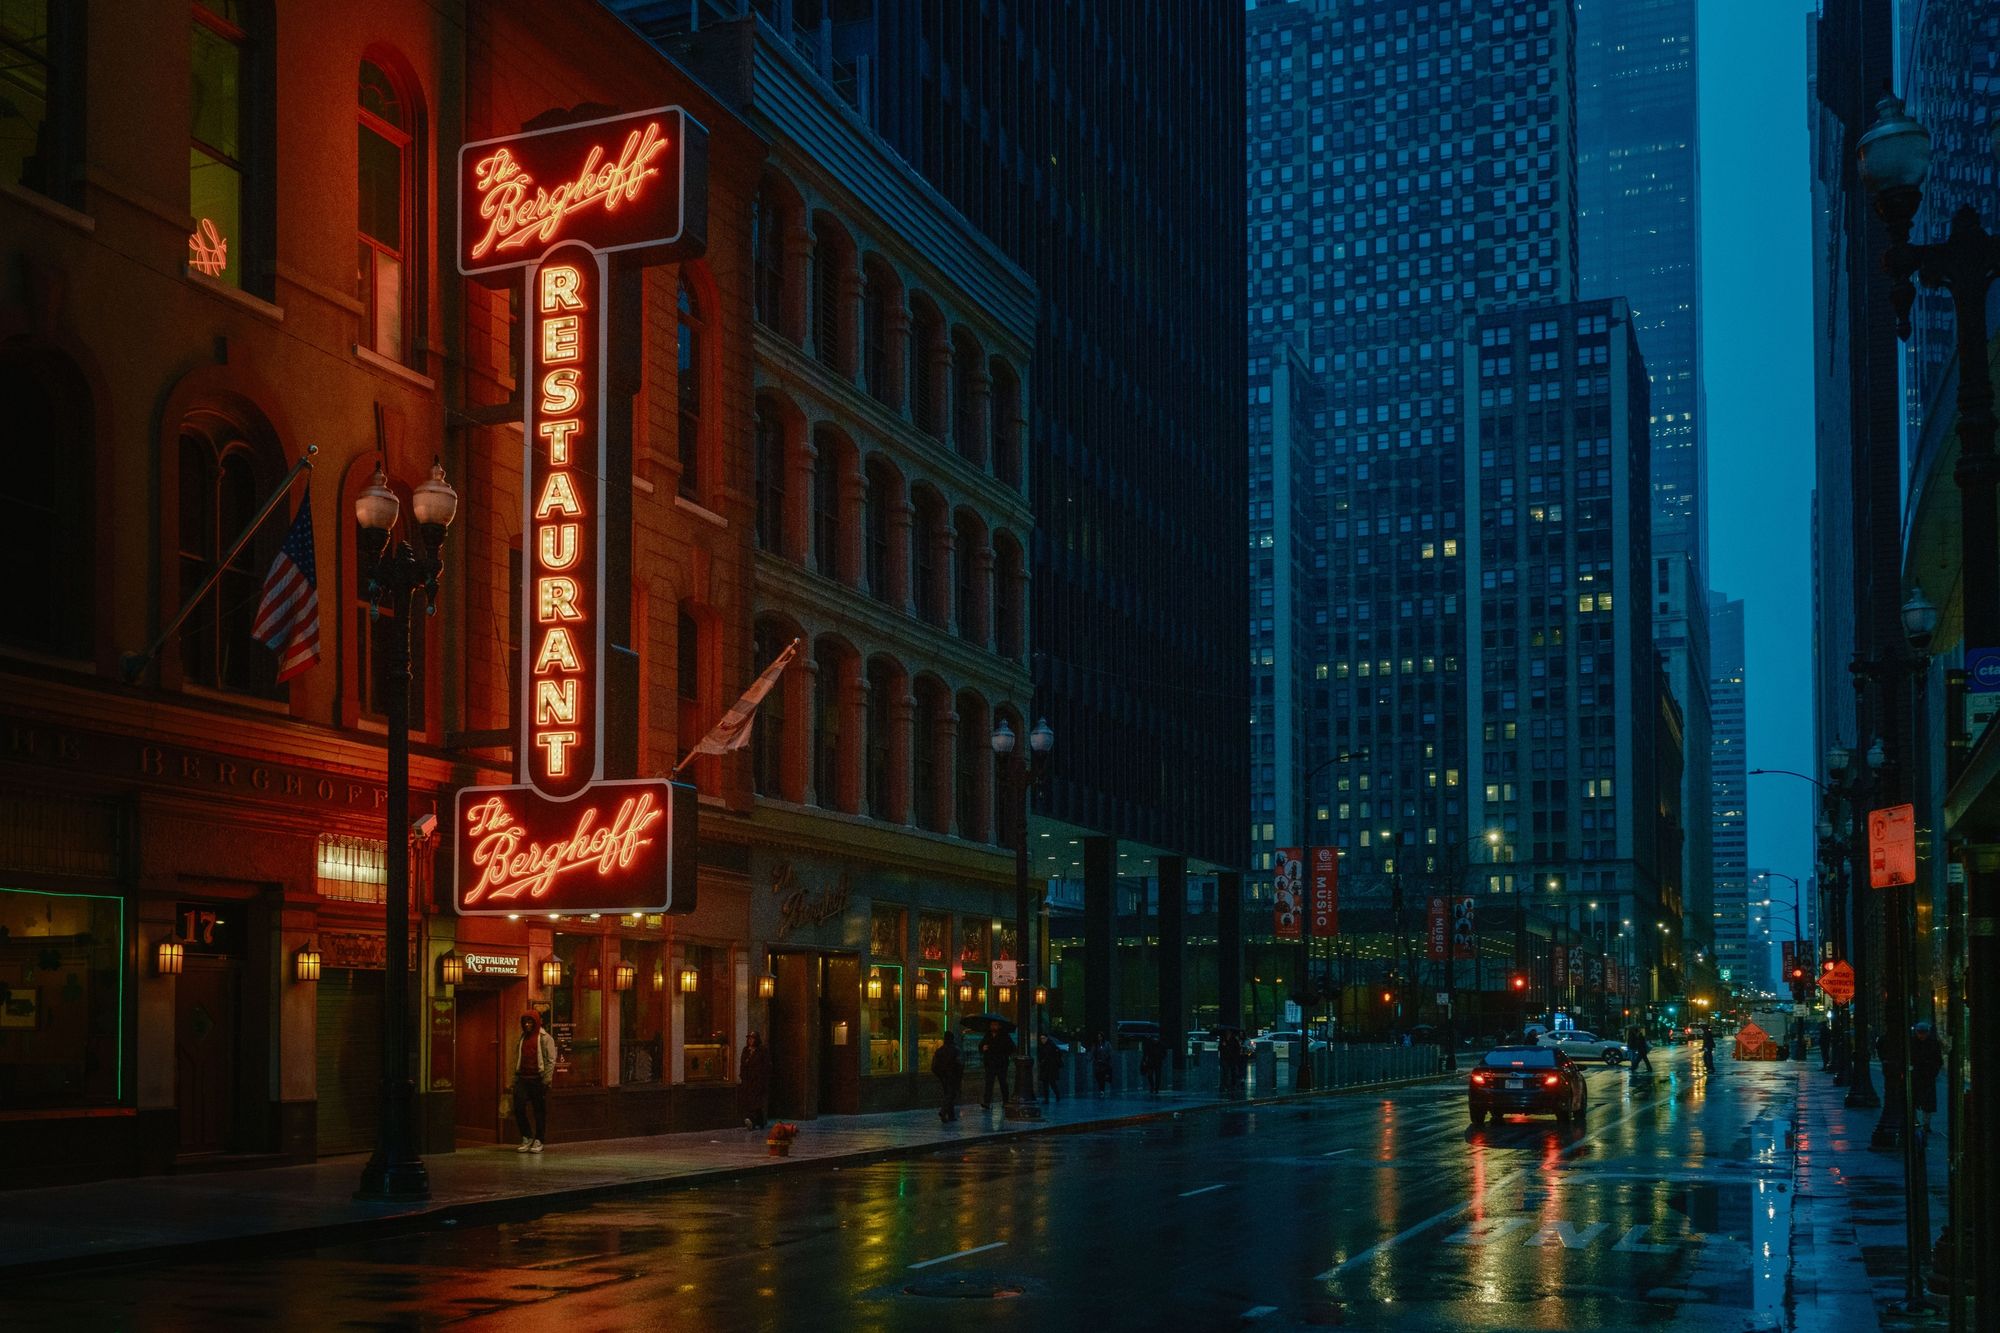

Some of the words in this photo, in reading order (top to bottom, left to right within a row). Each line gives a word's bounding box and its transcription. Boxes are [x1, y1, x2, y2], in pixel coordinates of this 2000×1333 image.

[471, 121, 670, 260] Berghoff
[473, 147, 521, 191] The
[535, 264, 585, 779] RESTAURANT
[138, 746, 388, 810] BERGHOFF
[467, 796, 514, 837] The
[463, 792, 664, 906] Berghoff
[1316, 876, 1327, 926] MUSIC
[183, 911, 216, 945] 17
[1435, 917, 1444, 953] MUSIC
[485, 966, 518, 974] ENTRANCE
